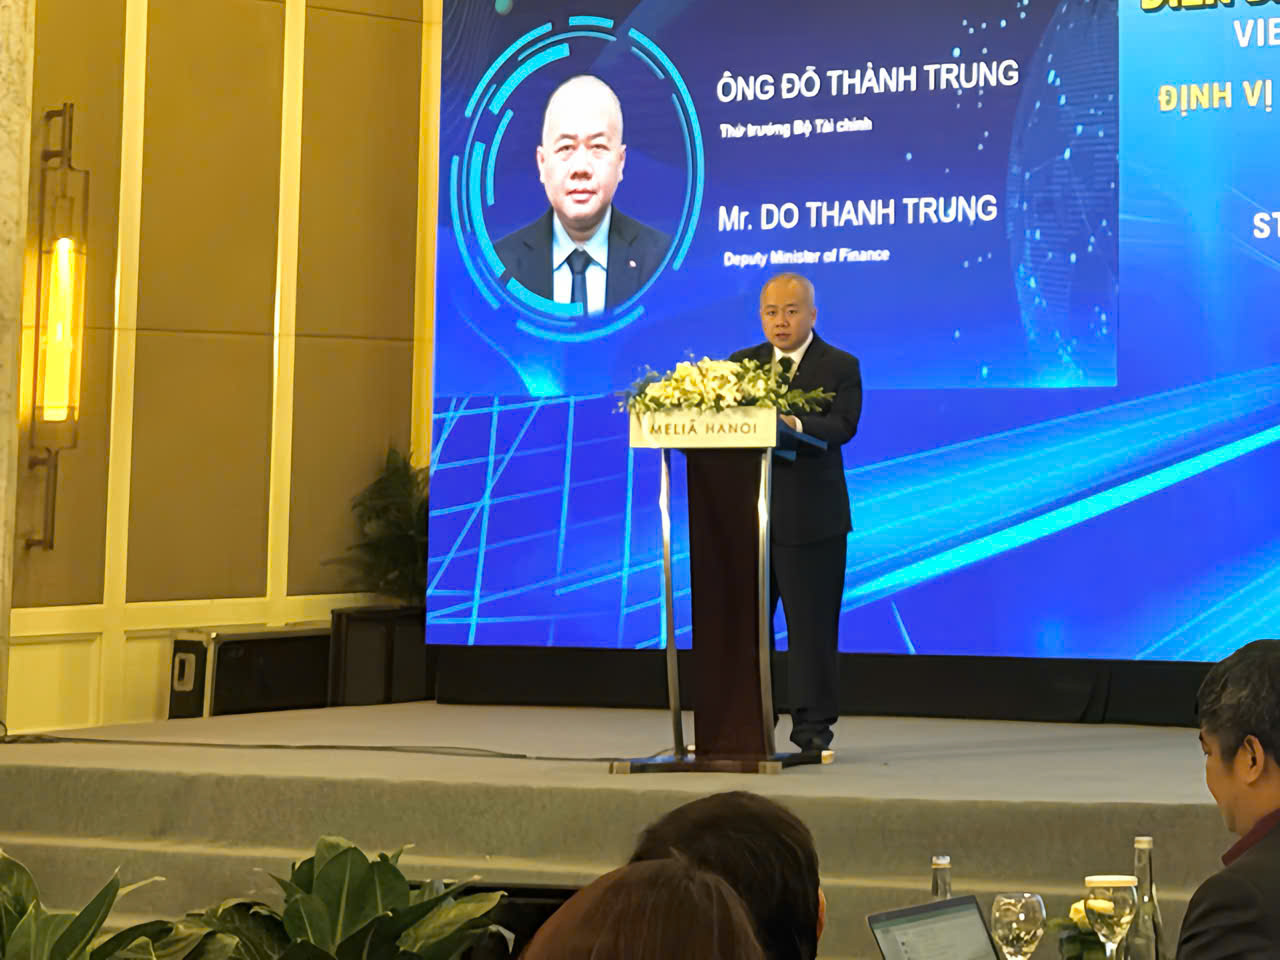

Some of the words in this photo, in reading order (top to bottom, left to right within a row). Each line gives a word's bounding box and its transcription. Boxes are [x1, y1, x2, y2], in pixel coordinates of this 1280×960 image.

[717, 70, 775, 103] ÔNG
[826, 61, 917, 96] THÀNH
[923, 59, 1019, 90] TRUNG
[1158, 82, 1232, 117] ĐỊNH
[1242, 79, 1273, 113] VỊ
[718, 205, 752, 232] Mr.
[760, 202, 799, 230] DO
[805, 198, 895, 228] THANH
[903, 194, 997, 224] TRUNG
[724, 251, 767, 268] Deputy
[770, 248, 821, 264] Minister
[823, 248, 837, 263] of
[839, 247, 890, 263] Finance
[706, 423, 757, 434] HANOI
